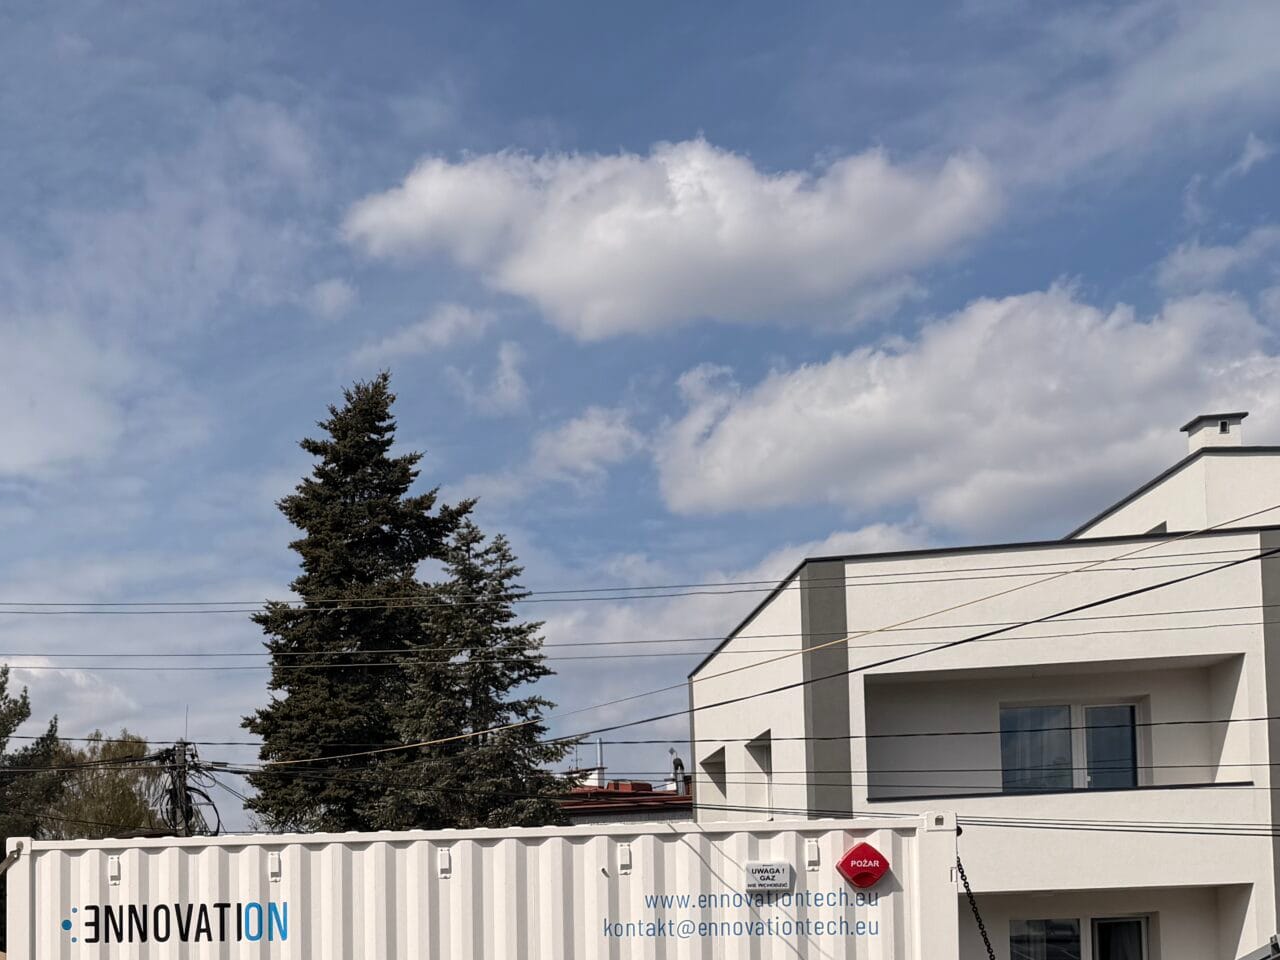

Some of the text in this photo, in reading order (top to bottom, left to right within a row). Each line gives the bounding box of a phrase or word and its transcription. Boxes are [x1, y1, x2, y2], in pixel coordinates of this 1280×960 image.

[850, 858, 880, 868] POŻAR
[644, 887, 879, 910] www.ennovationtech.eu
[603, 915, 879, 939] kontakt@ennovationtech.eu
